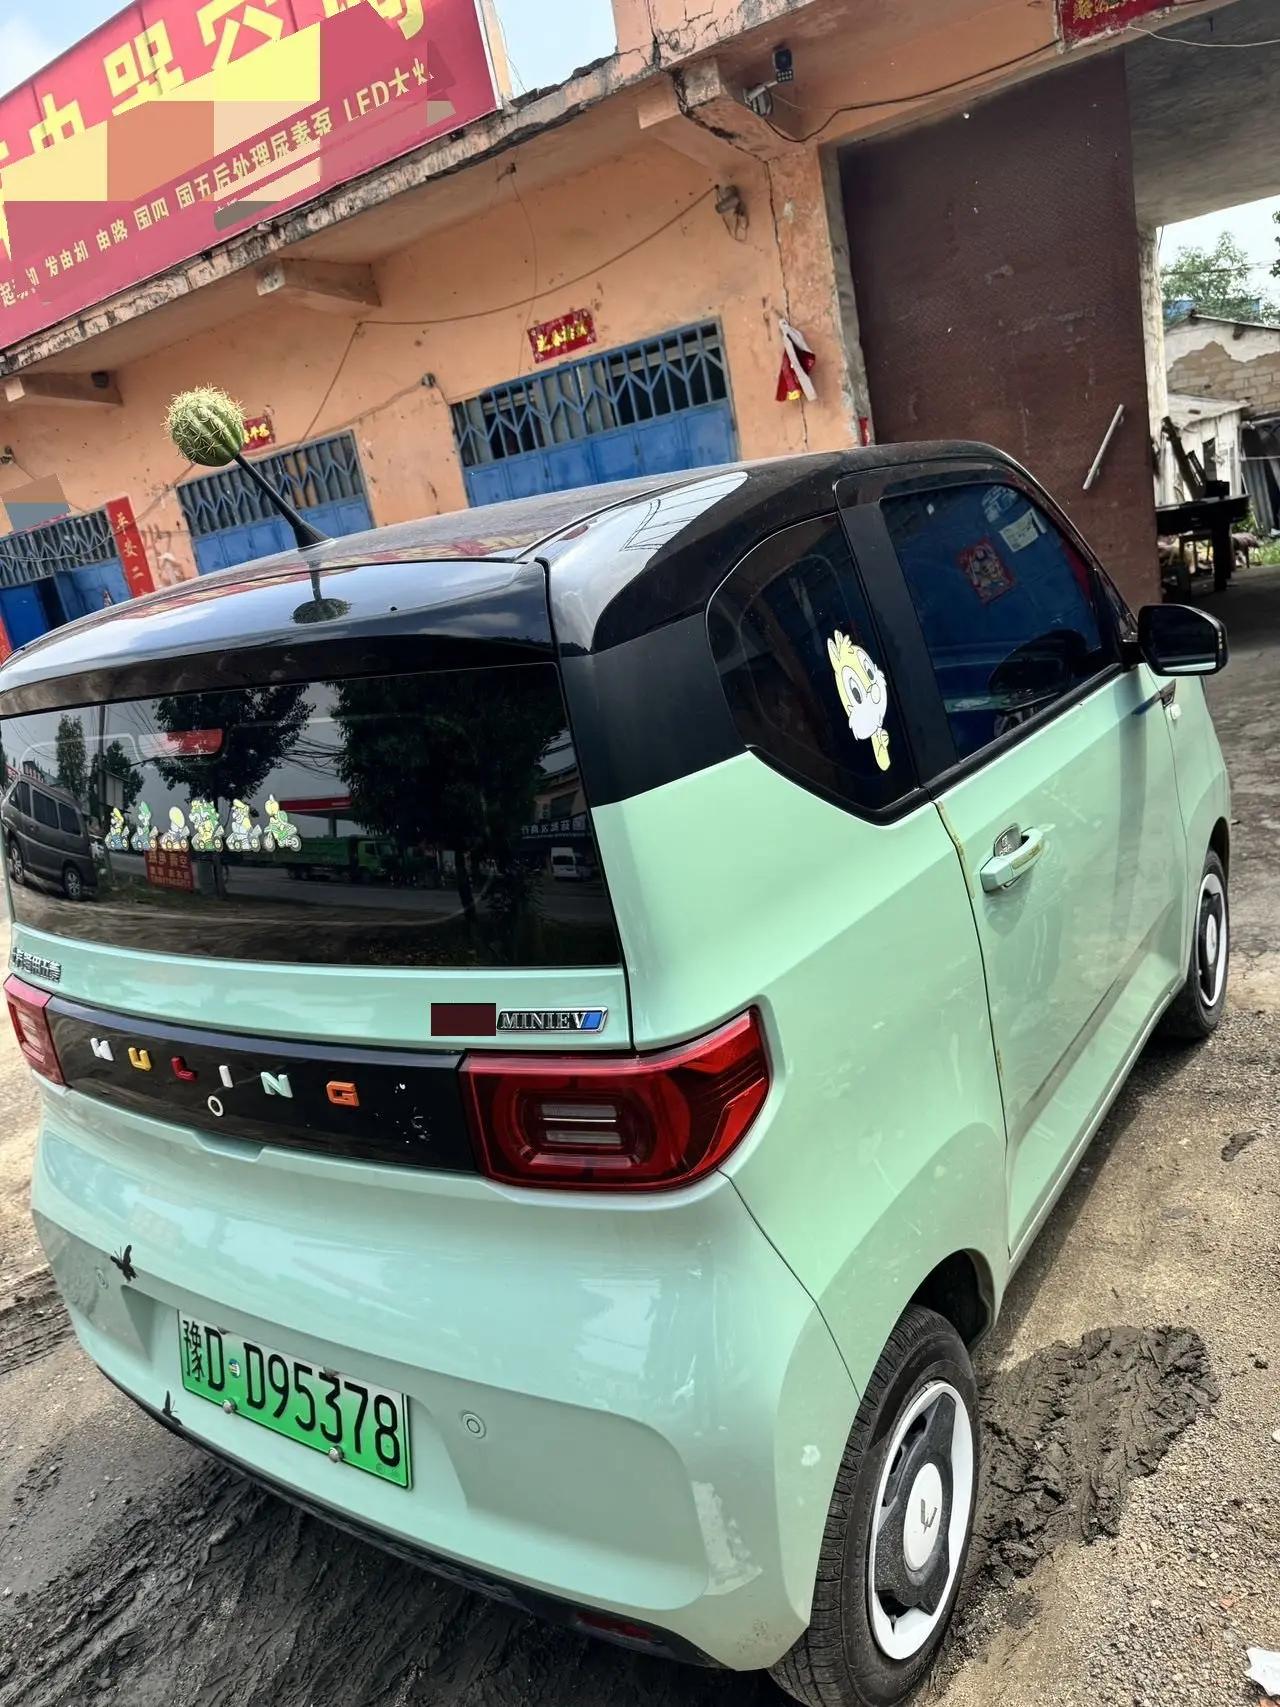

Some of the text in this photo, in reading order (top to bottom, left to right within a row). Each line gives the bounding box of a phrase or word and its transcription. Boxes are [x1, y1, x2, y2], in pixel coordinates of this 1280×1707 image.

[133, 197, 170, 232] 国四
[116, 511, 147, 597] 平安二
[500, 1012, 587, 1029] MINIEV
[90, 1037, 360, 1107] WULING
